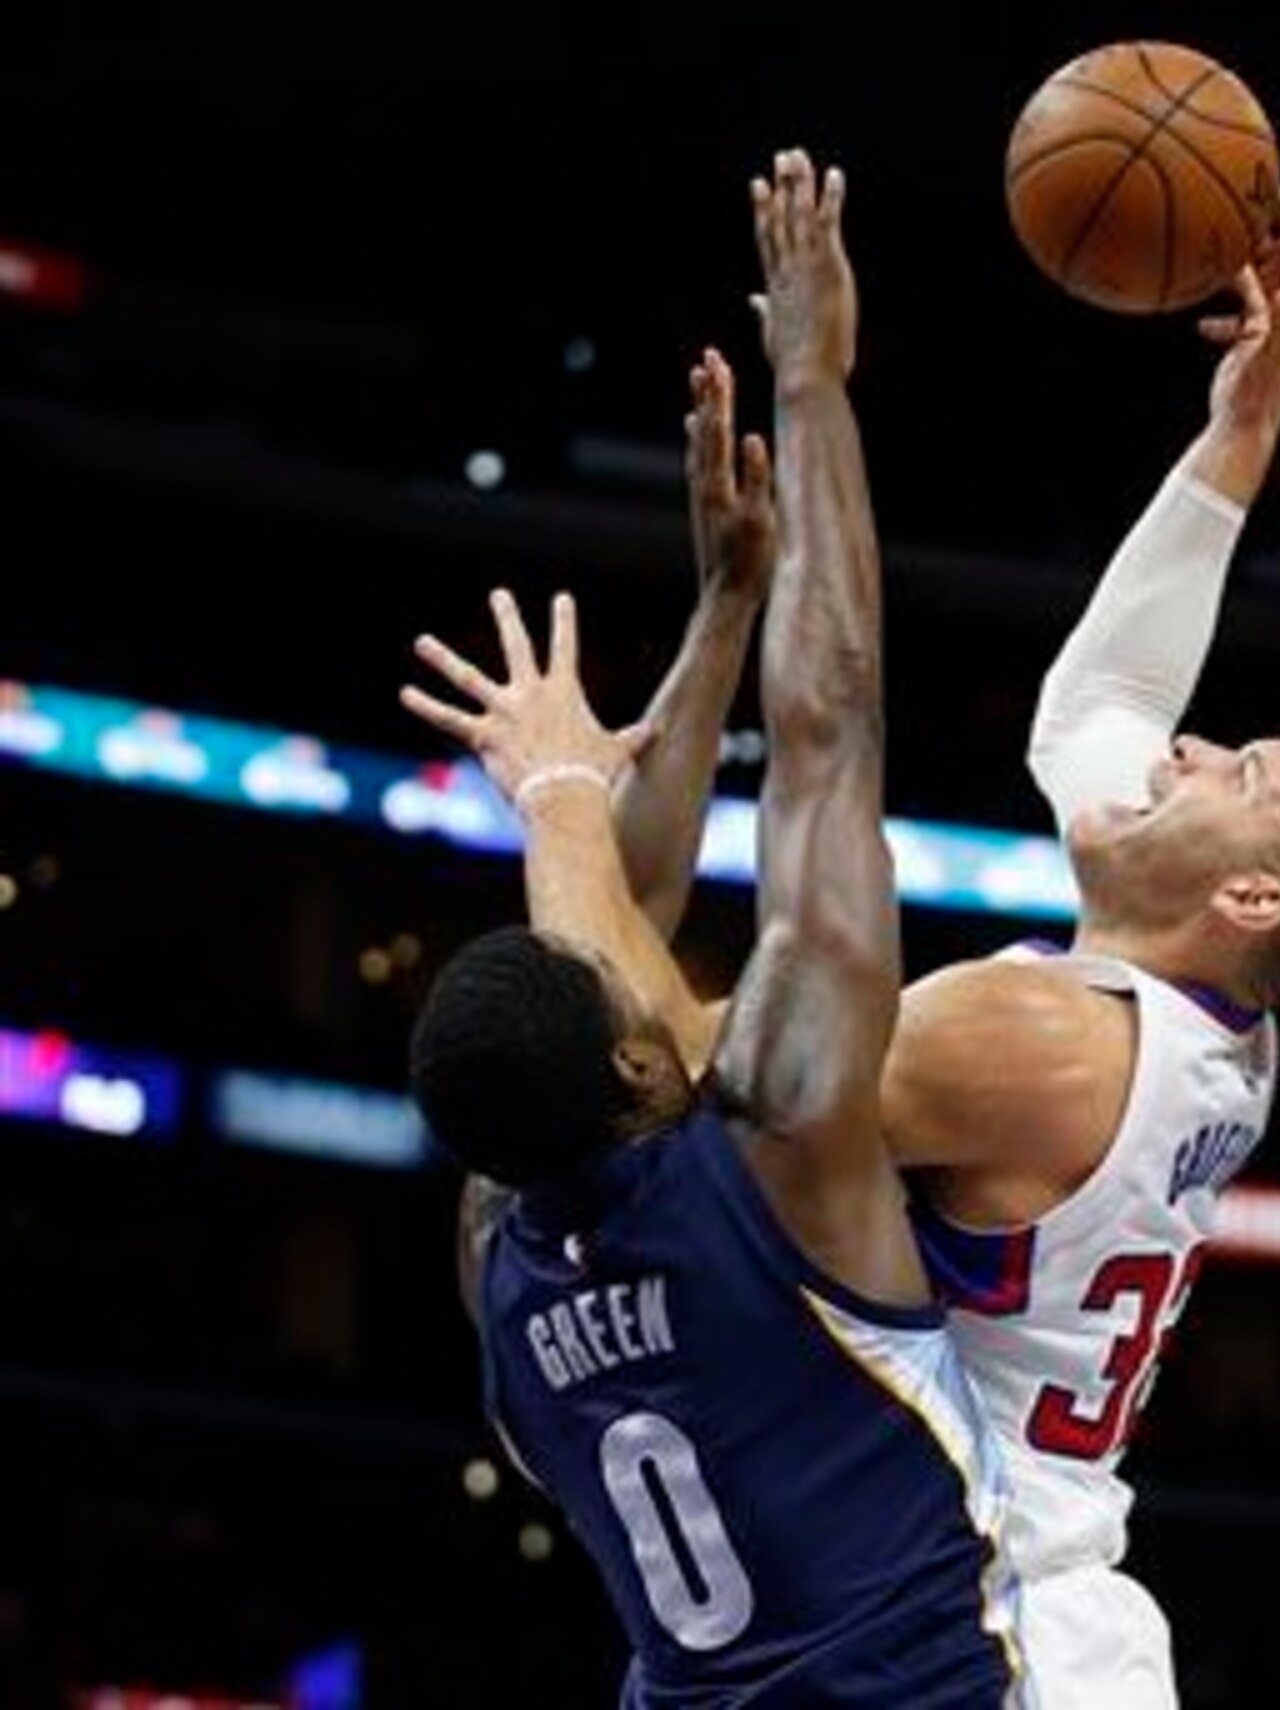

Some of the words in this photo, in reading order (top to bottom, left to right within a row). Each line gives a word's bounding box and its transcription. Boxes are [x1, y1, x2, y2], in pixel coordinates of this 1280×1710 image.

[527, 1276, 675, 1391] GREEN
[1026, 1247, 1200, 1460] 3
[602, 1412, 754, 1651] 0
